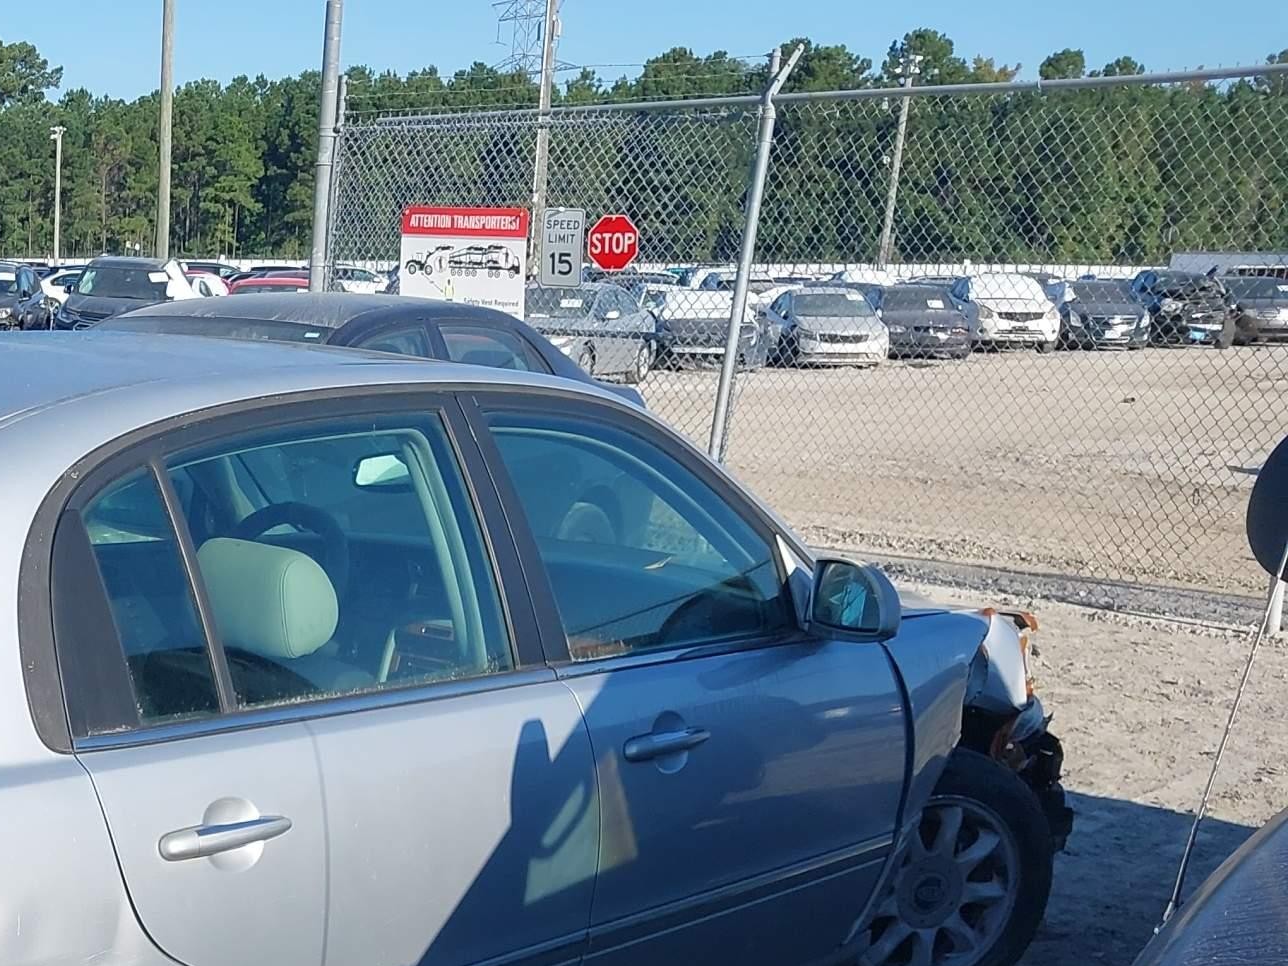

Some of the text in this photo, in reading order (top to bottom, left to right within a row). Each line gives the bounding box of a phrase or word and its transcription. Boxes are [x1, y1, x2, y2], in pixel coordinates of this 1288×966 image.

[409, 214, 520, 230] ATTENTION TRANSPORTERS!
[546, 219, 580, 230] SPEED
[548, 233, 576, 244] LIMIT
[591, 232, 636, 254] STOP
[549, 252, 573, 276] 15
[494, 299, 519, 308] Required
